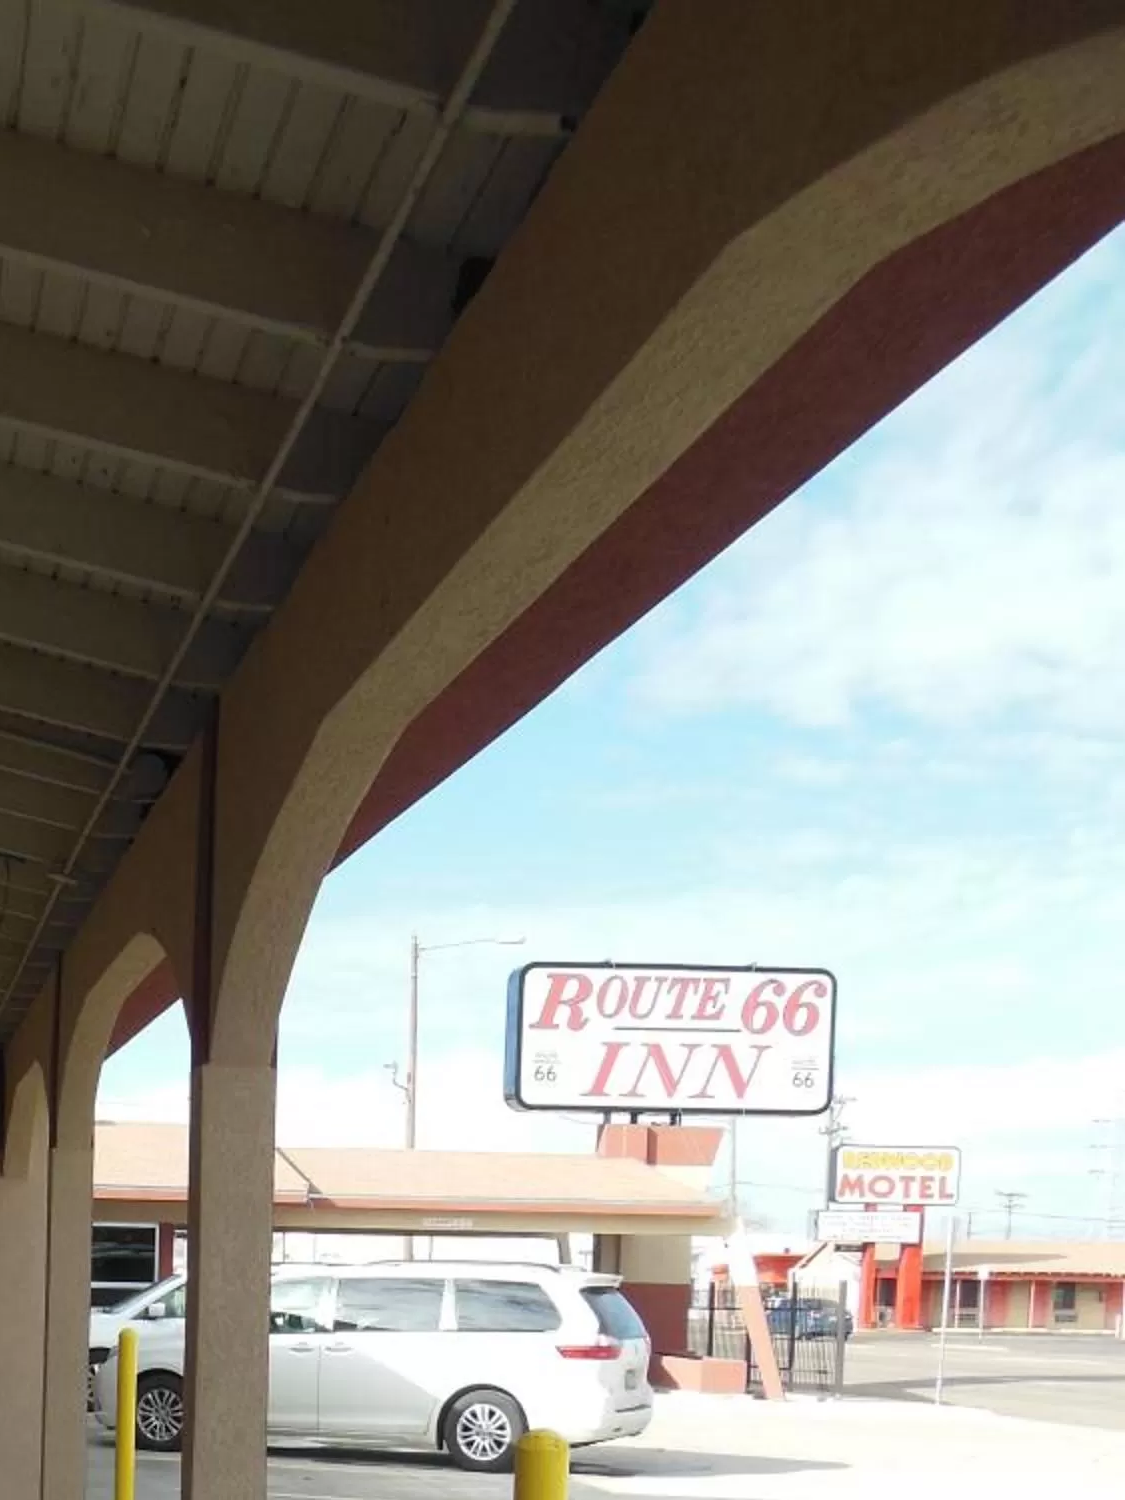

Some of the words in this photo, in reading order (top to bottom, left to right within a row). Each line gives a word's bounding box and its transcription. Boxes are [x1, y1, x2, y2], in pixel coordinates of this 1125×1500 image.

[529, 972, 731, 1032] ROUTE
[740, 978, 827, 1037] 66
[533, 1065, 557, 1082] 66
[579, 1041, 772, 1100] INN
[792, 1071, 815, 1089] 66
[837, 1172, 956, 1199] MOTEL
